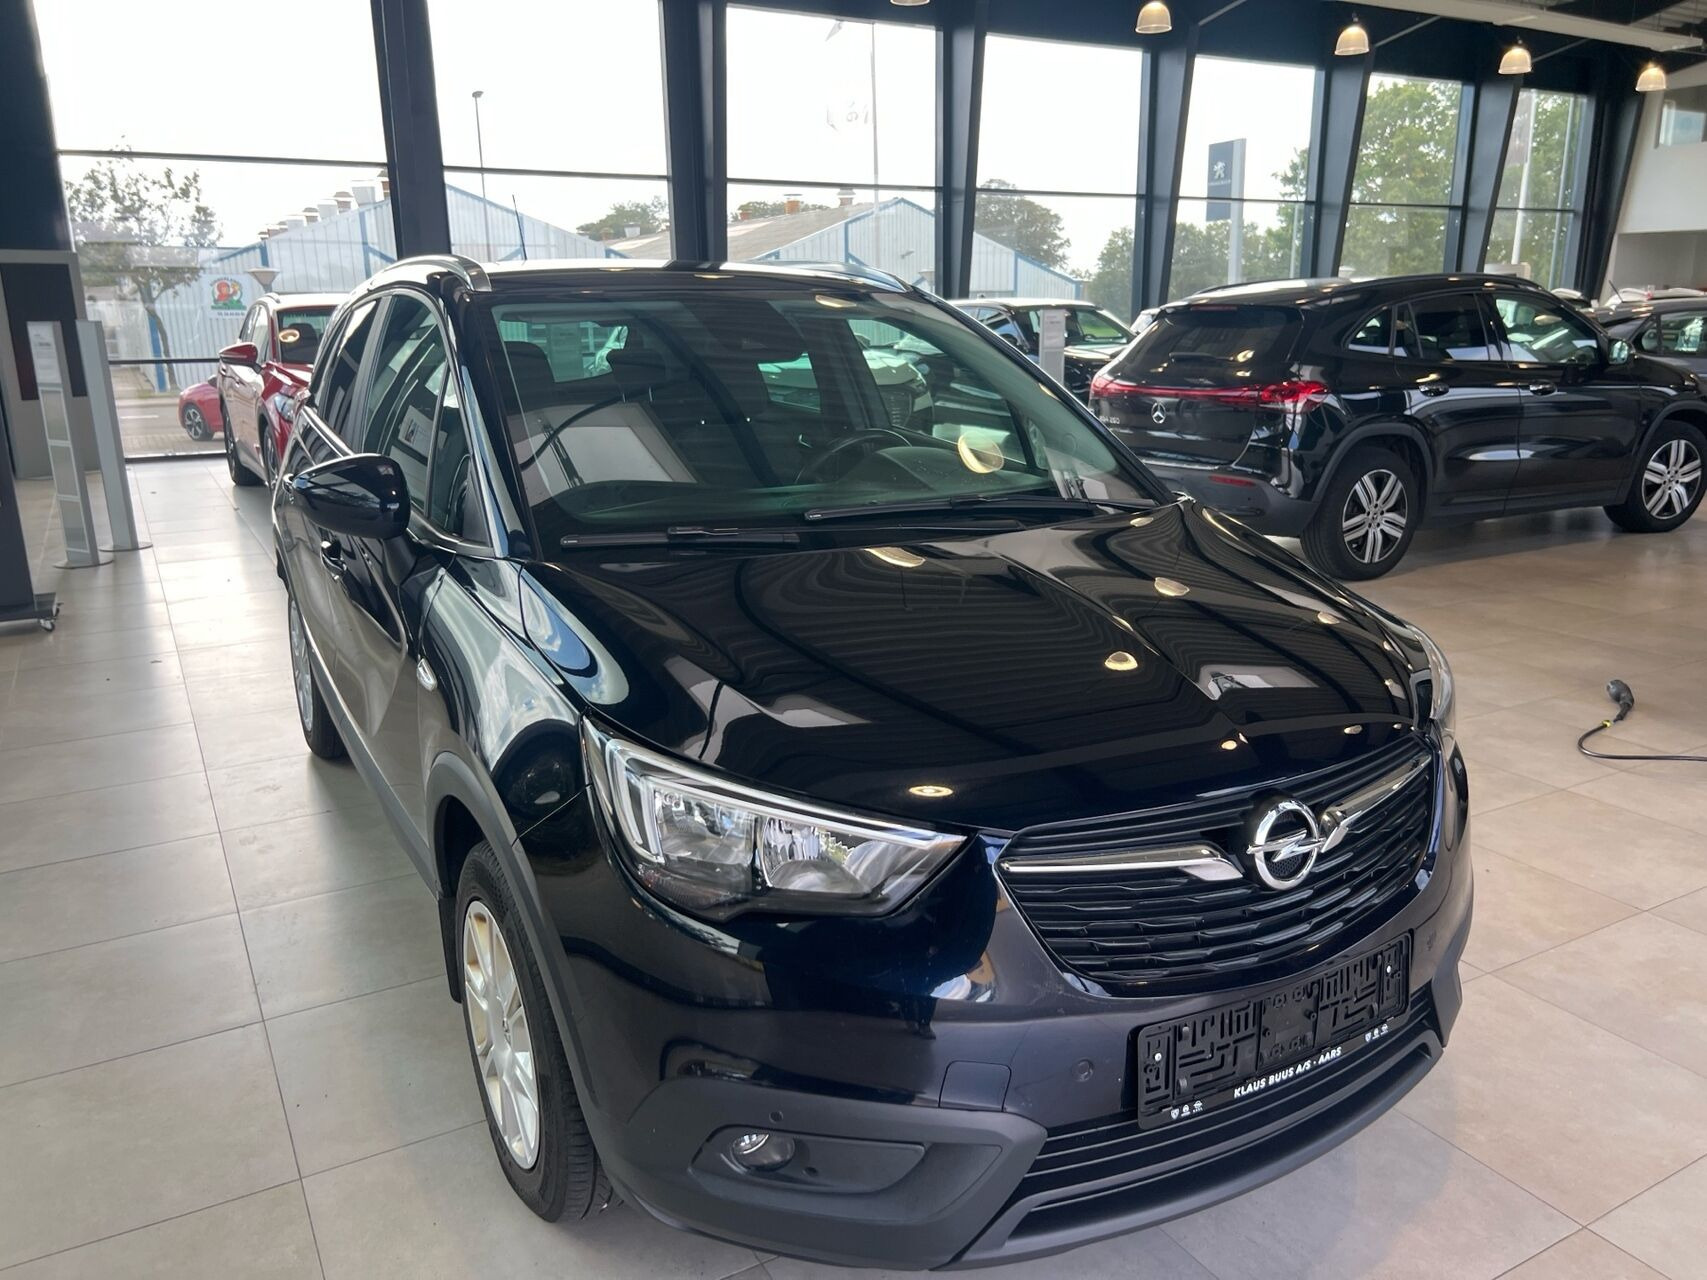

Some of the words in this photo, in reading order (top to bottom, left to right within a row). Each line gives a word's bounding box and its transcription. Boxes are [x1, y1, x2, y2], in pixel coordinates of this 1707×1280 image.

[1234, 1078, 1266, 1098] KLAUS
[1268, 1067, 1294, 1085] BUUS
[1295, 1060, 1311, 1074] A/S
[1318, 1046, 1341, 1064] AARS
